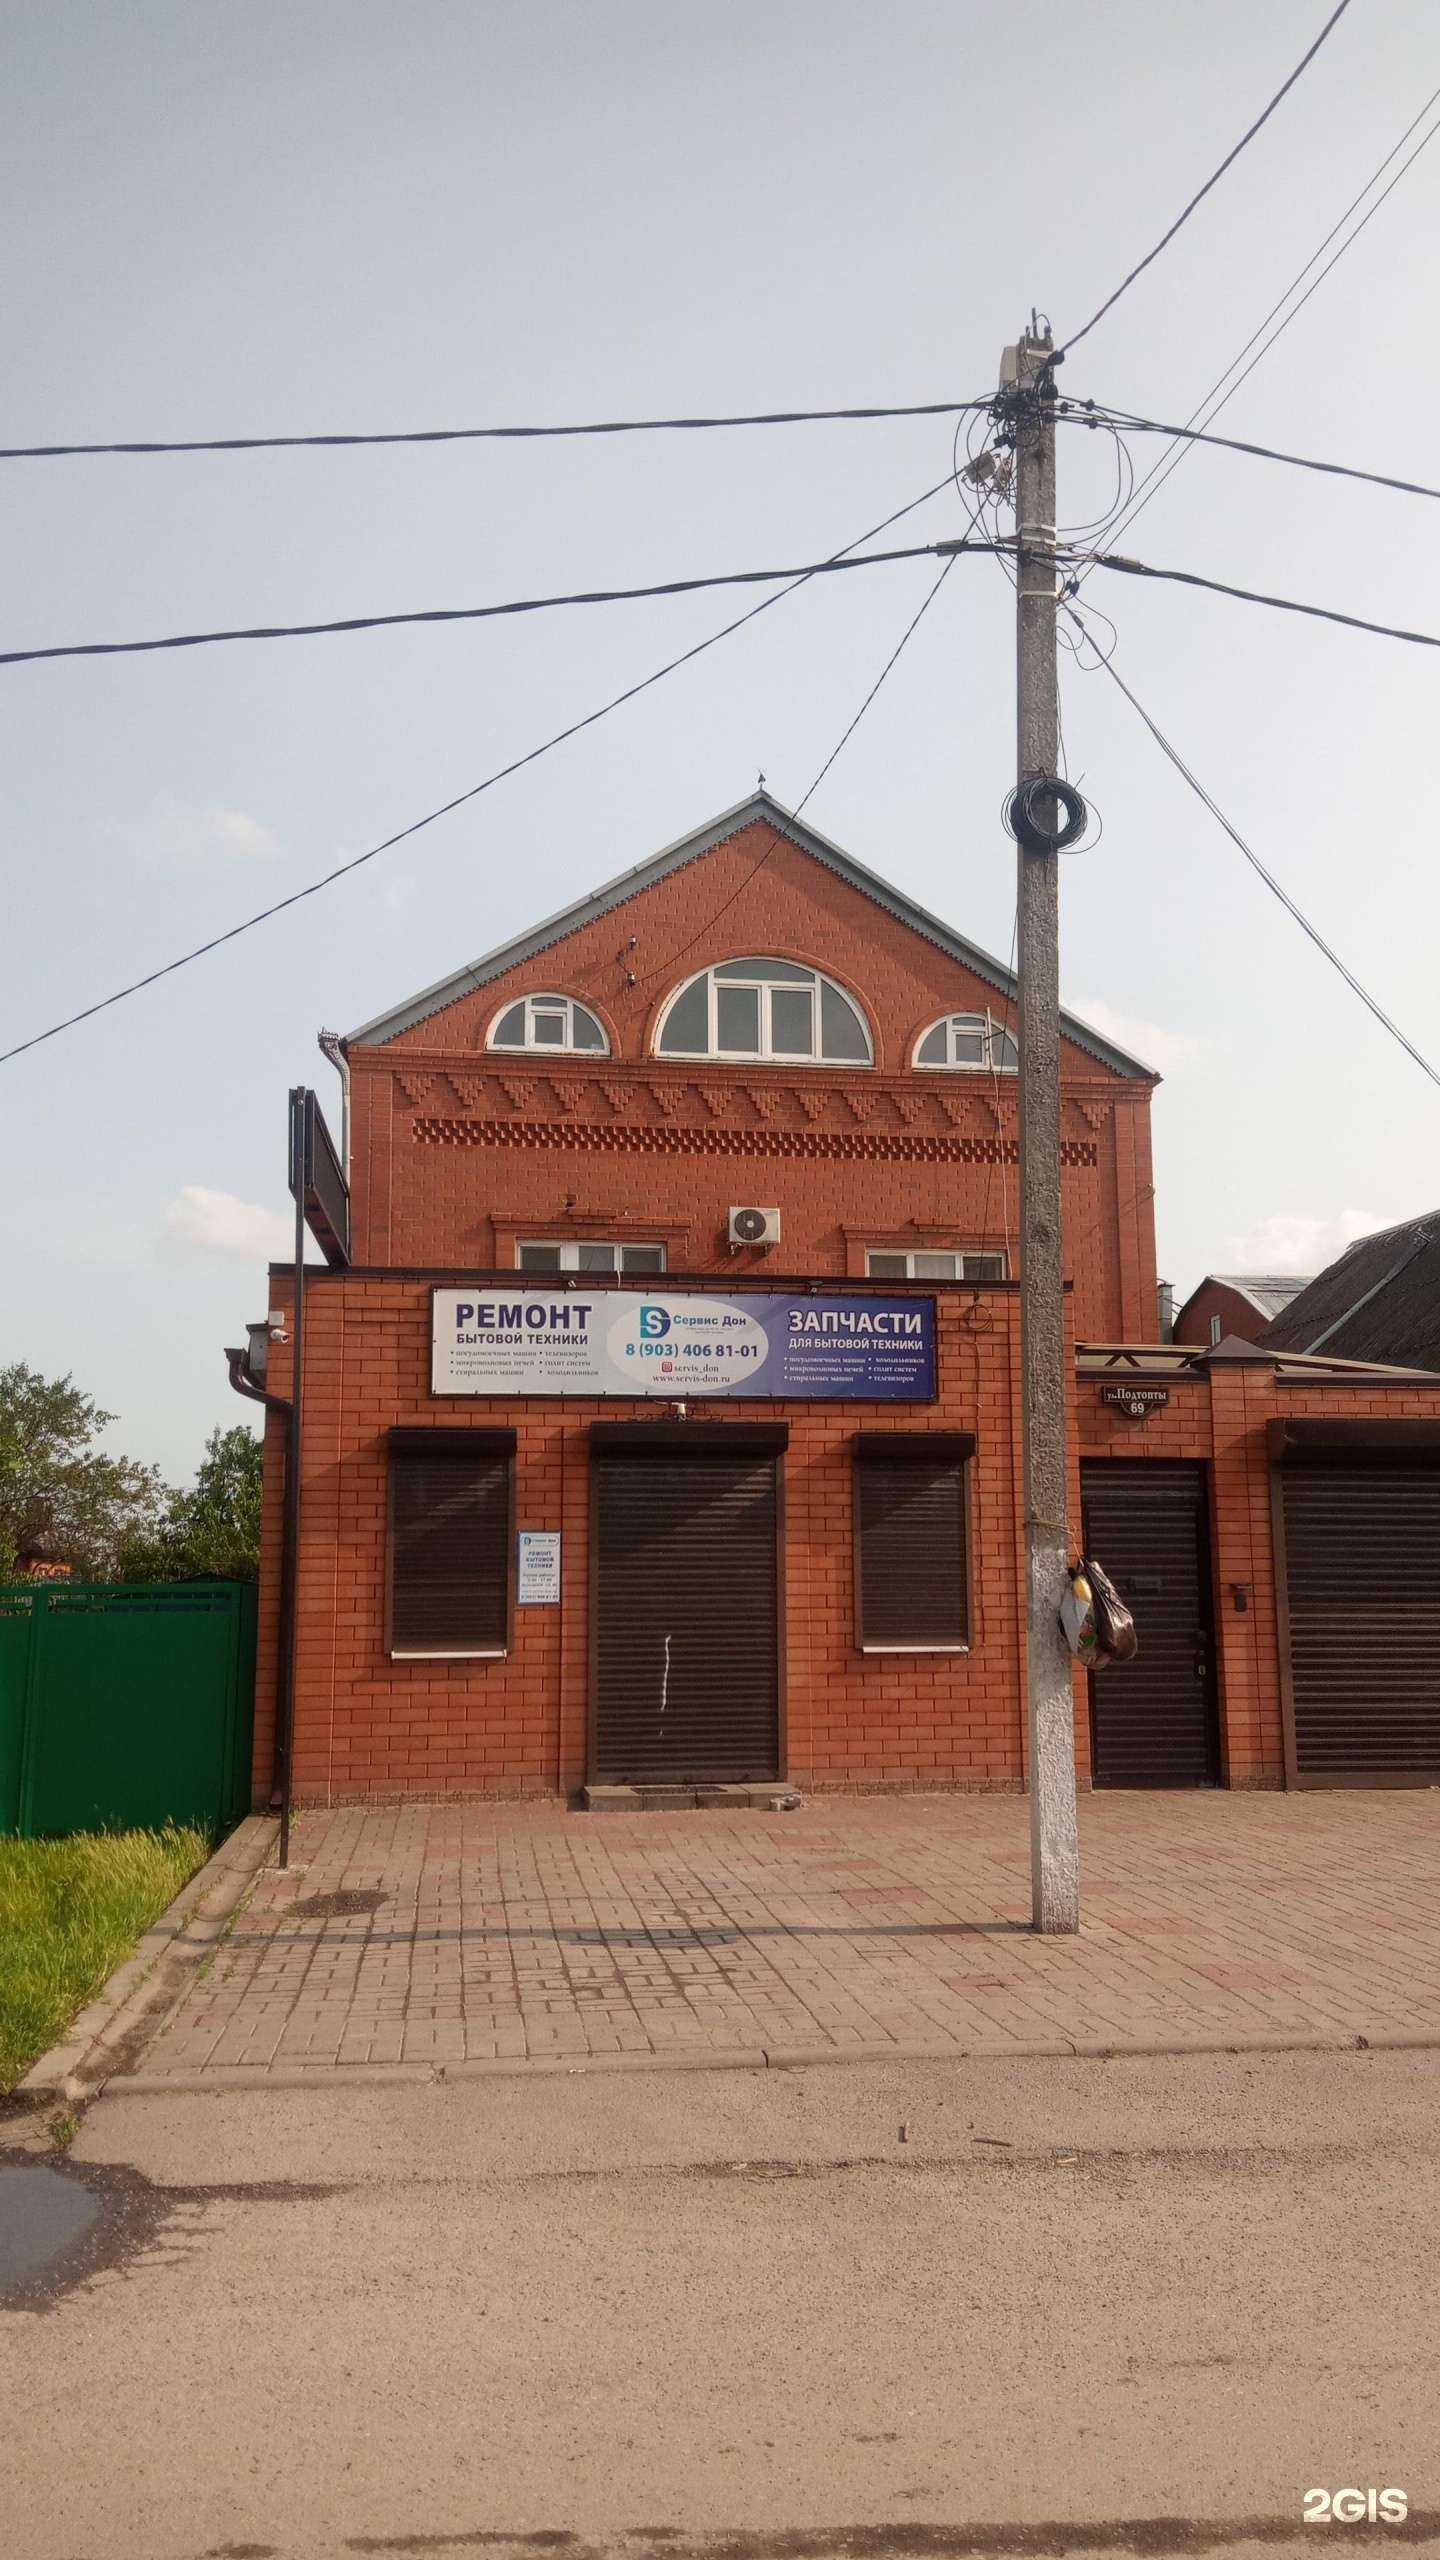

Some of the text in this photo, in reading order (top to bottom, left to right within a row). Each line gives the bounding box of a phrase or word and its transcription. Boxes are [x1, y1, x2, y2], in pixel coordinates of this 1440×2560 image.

[456, 1303, 592, 1329] РЕМОНТ
[673, 1315, 746, 1328] Сервис Дон
[789, 1311, 922, 1334] ЗАПЧАСТИ
[457, 1332, 588, 1345] БЫТОВОЙ ТЕХНИКИ
[789, 1337, 923, 1350] ДЛЯ БЫТОВОЙ ТЕХНИКИ
[626, 1343, 758, 1358] 8 (903) 406 81-01
[674, 1363, 719, 1373] servis_don
[652, 1374, 730, 1383] www.servis-don.ru
[1130, 1402, 1145, 1413] 69
